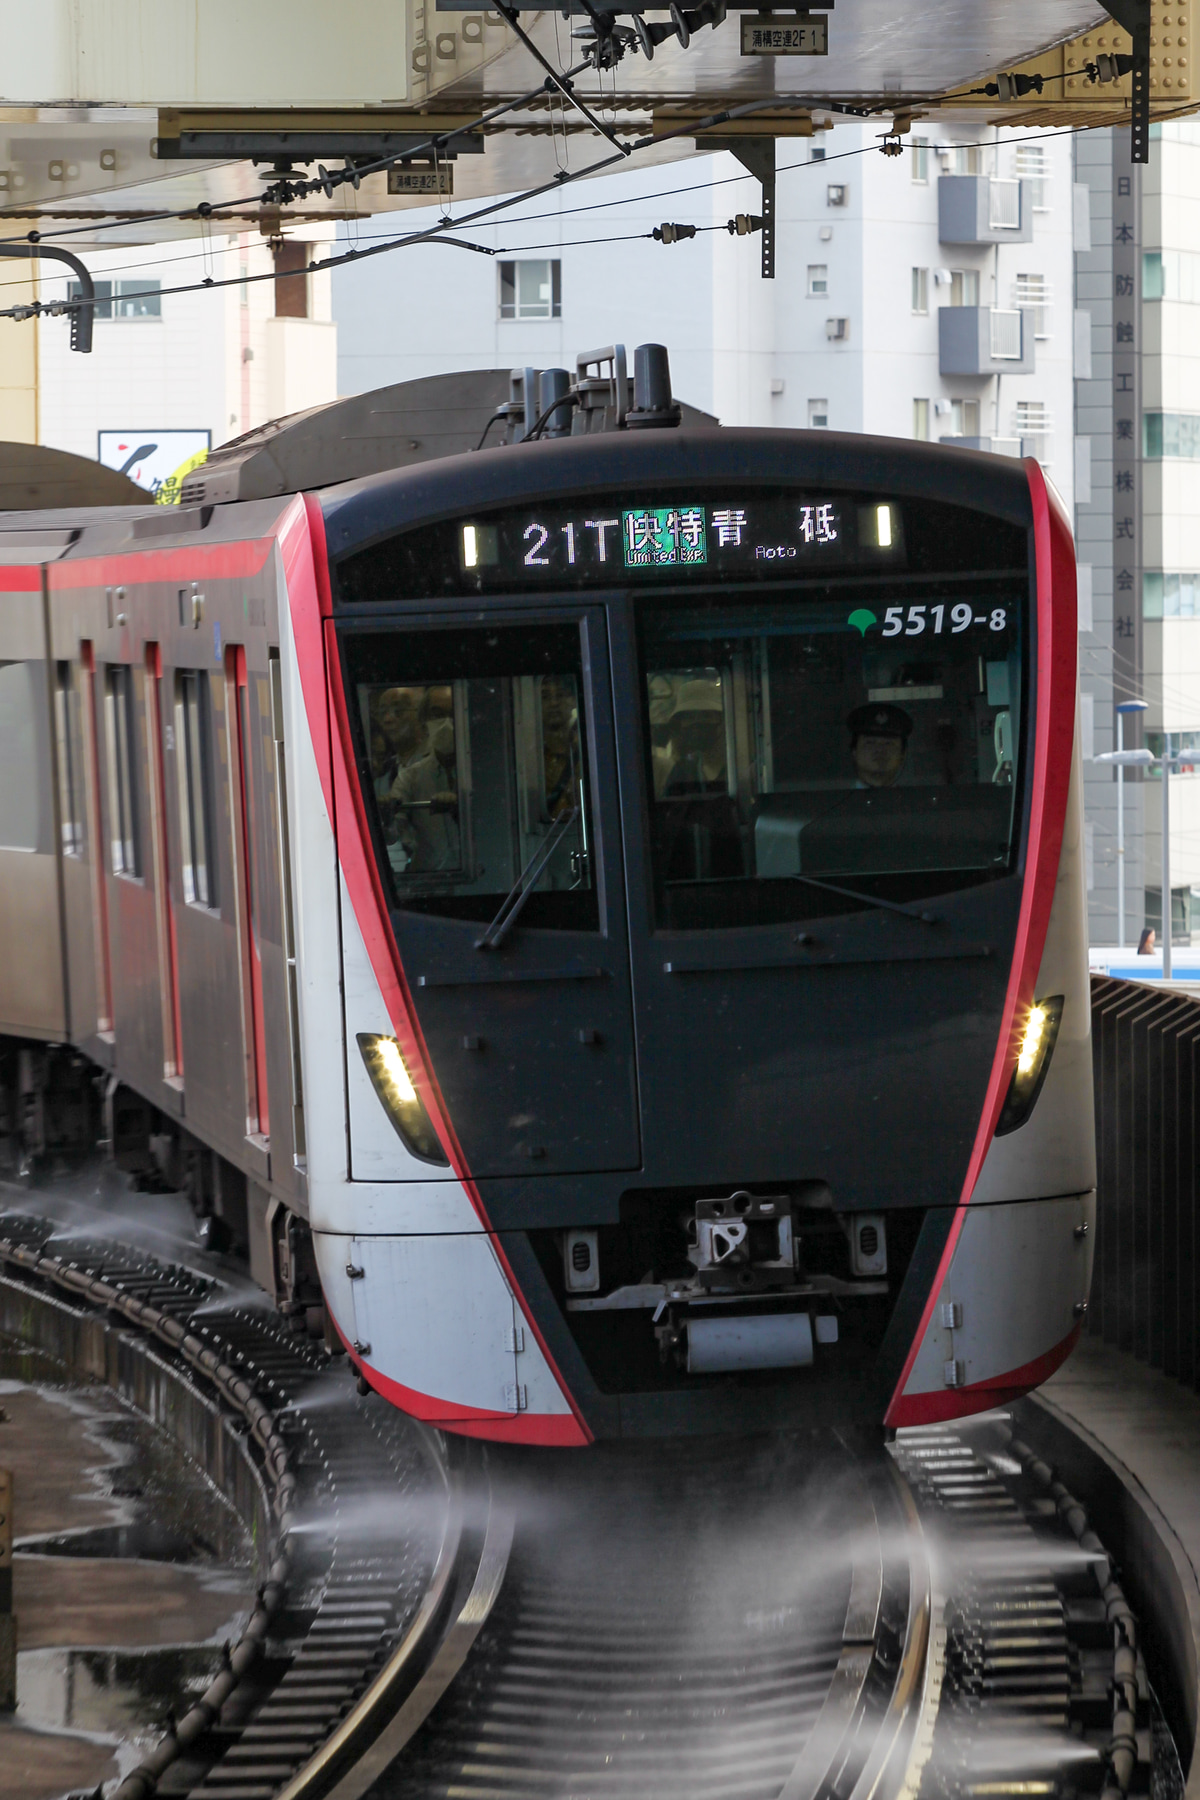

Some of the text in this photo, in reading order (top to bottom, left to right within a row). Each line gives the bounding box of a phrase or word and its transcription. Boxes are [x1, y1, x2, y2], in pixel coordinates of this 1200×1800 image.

[811, 30, 816, 46] 1
[523, 519, 619, 566] 21T
[625, 510, 703, 550] 快特
[627, 548, 677, 565] Limited
[755, 545, 797, 559] Aoto
[881, 602, 1007, 637] 5519-8
